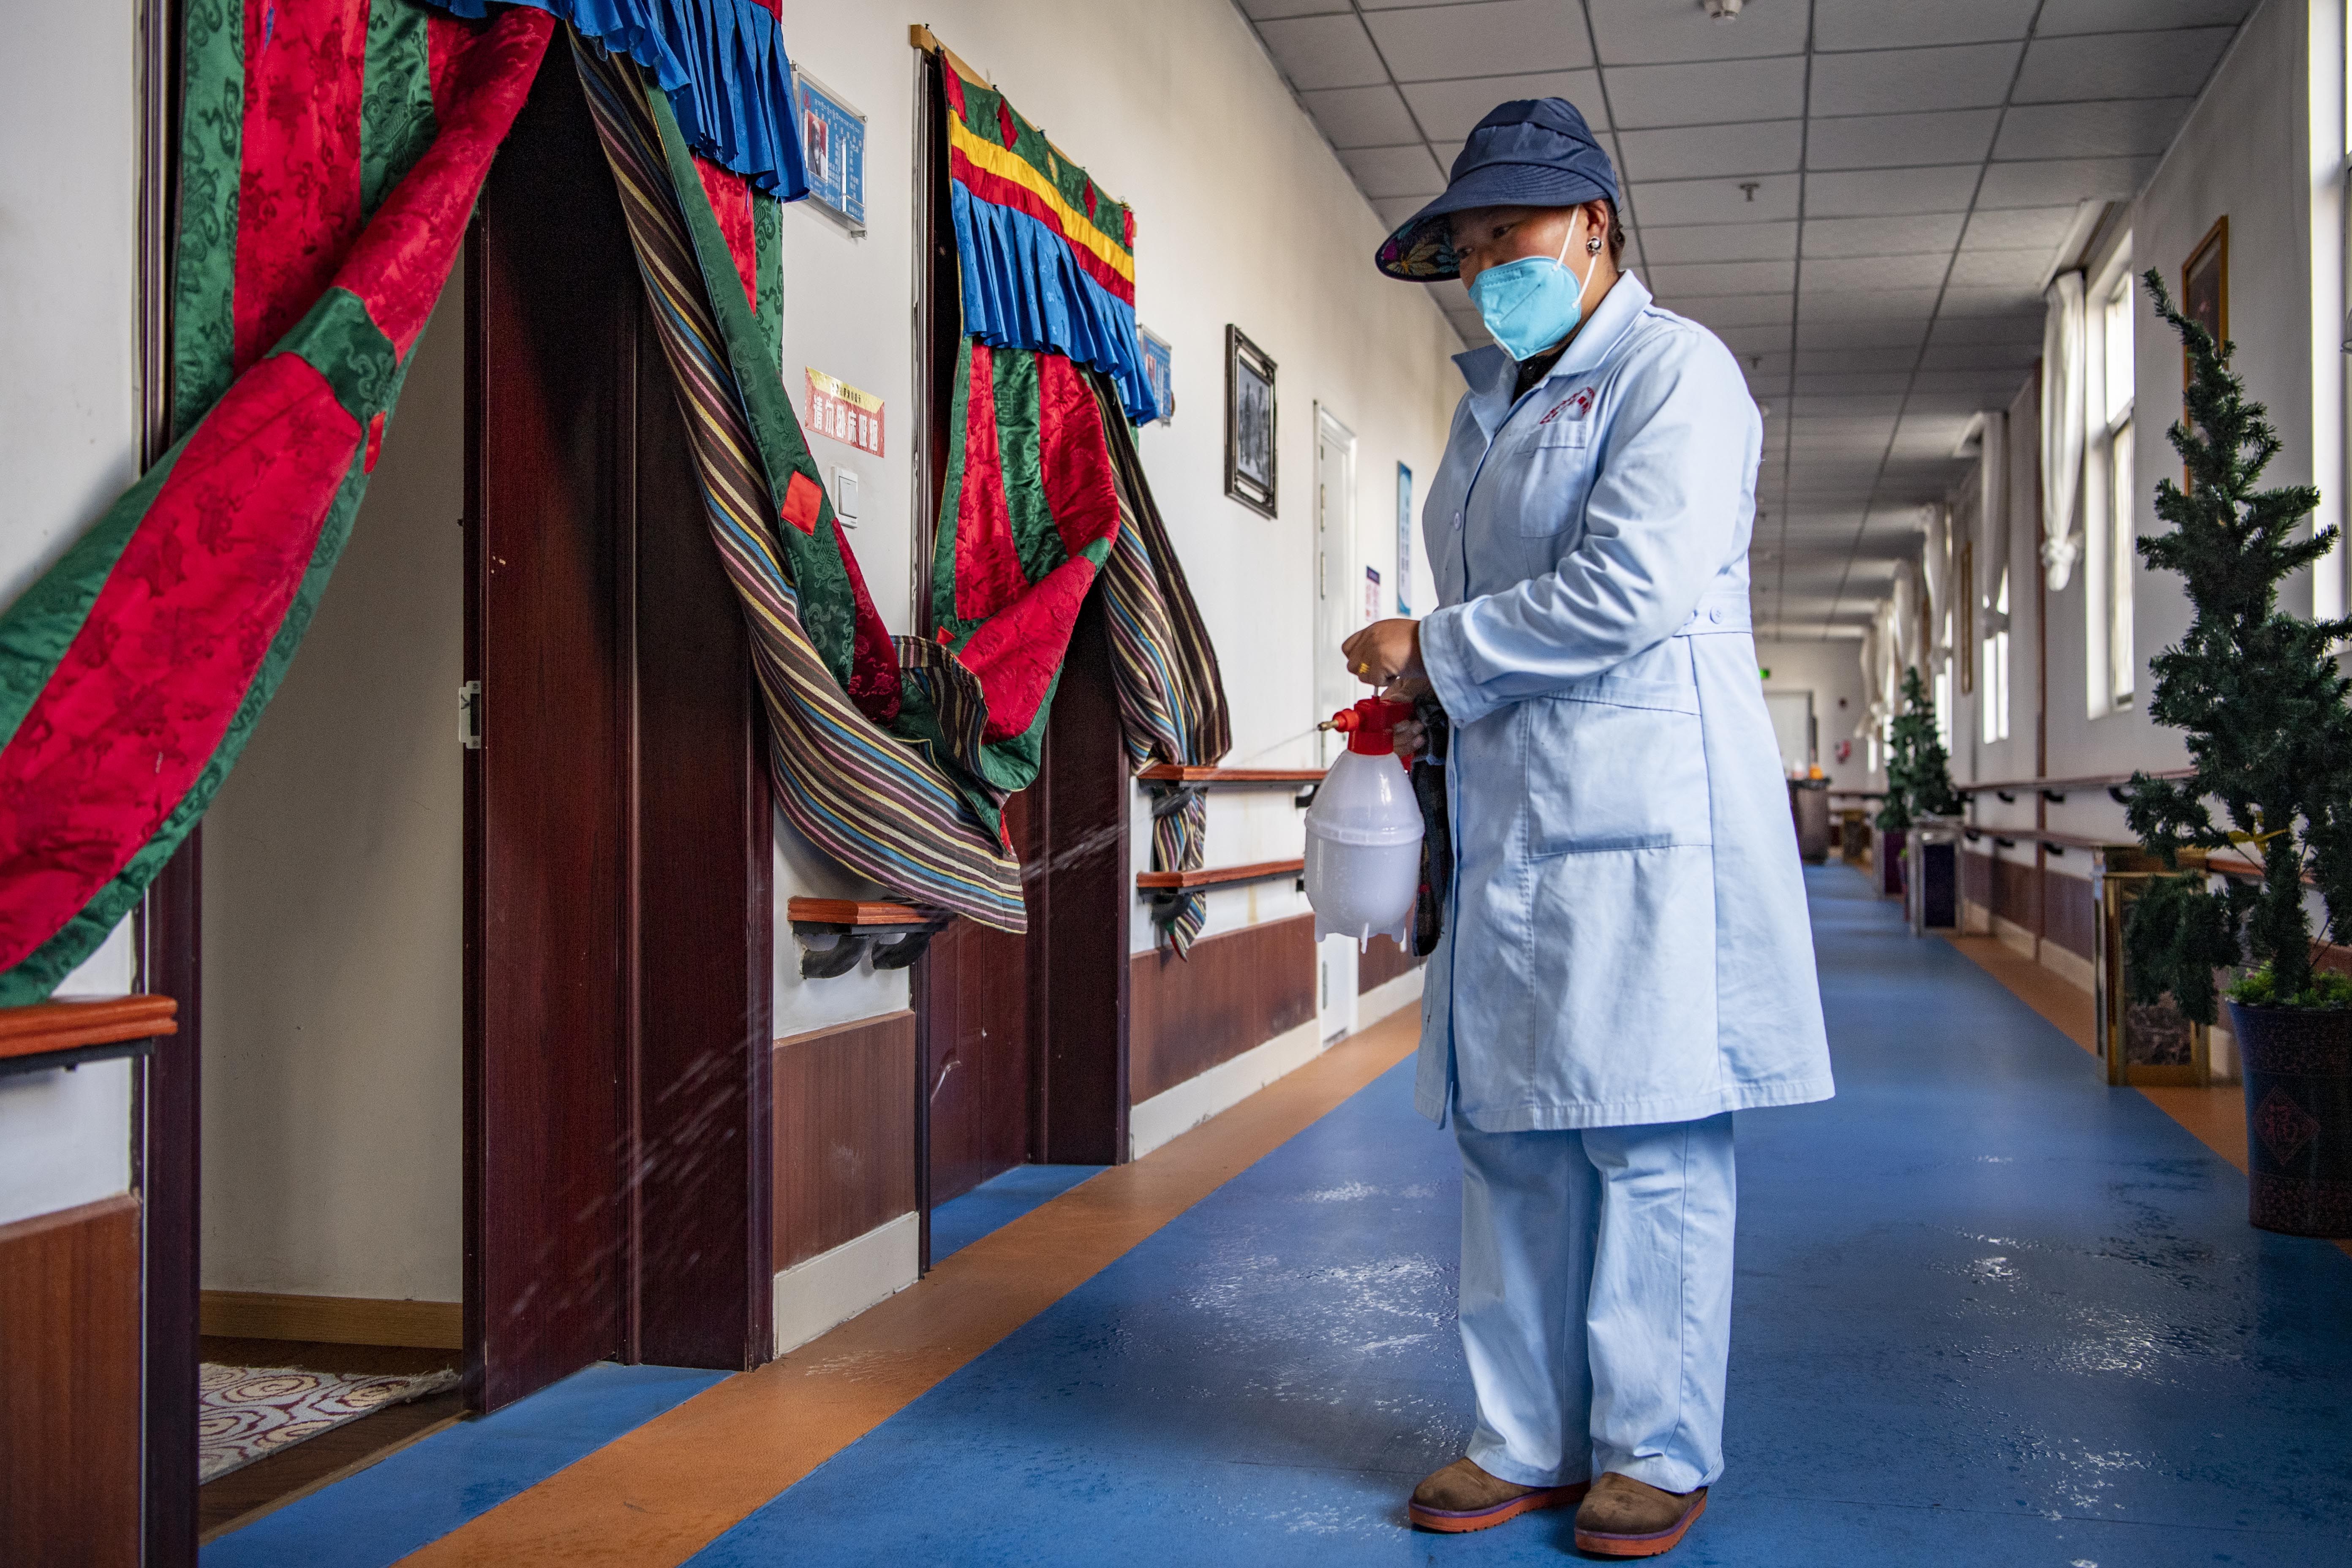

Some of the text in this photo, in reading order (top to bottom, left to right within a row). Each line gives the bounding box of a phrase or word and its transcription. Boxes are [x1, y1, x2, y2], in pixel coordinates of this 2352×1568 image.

[814, 393, 878, 451] 请勿卧床吸烟
